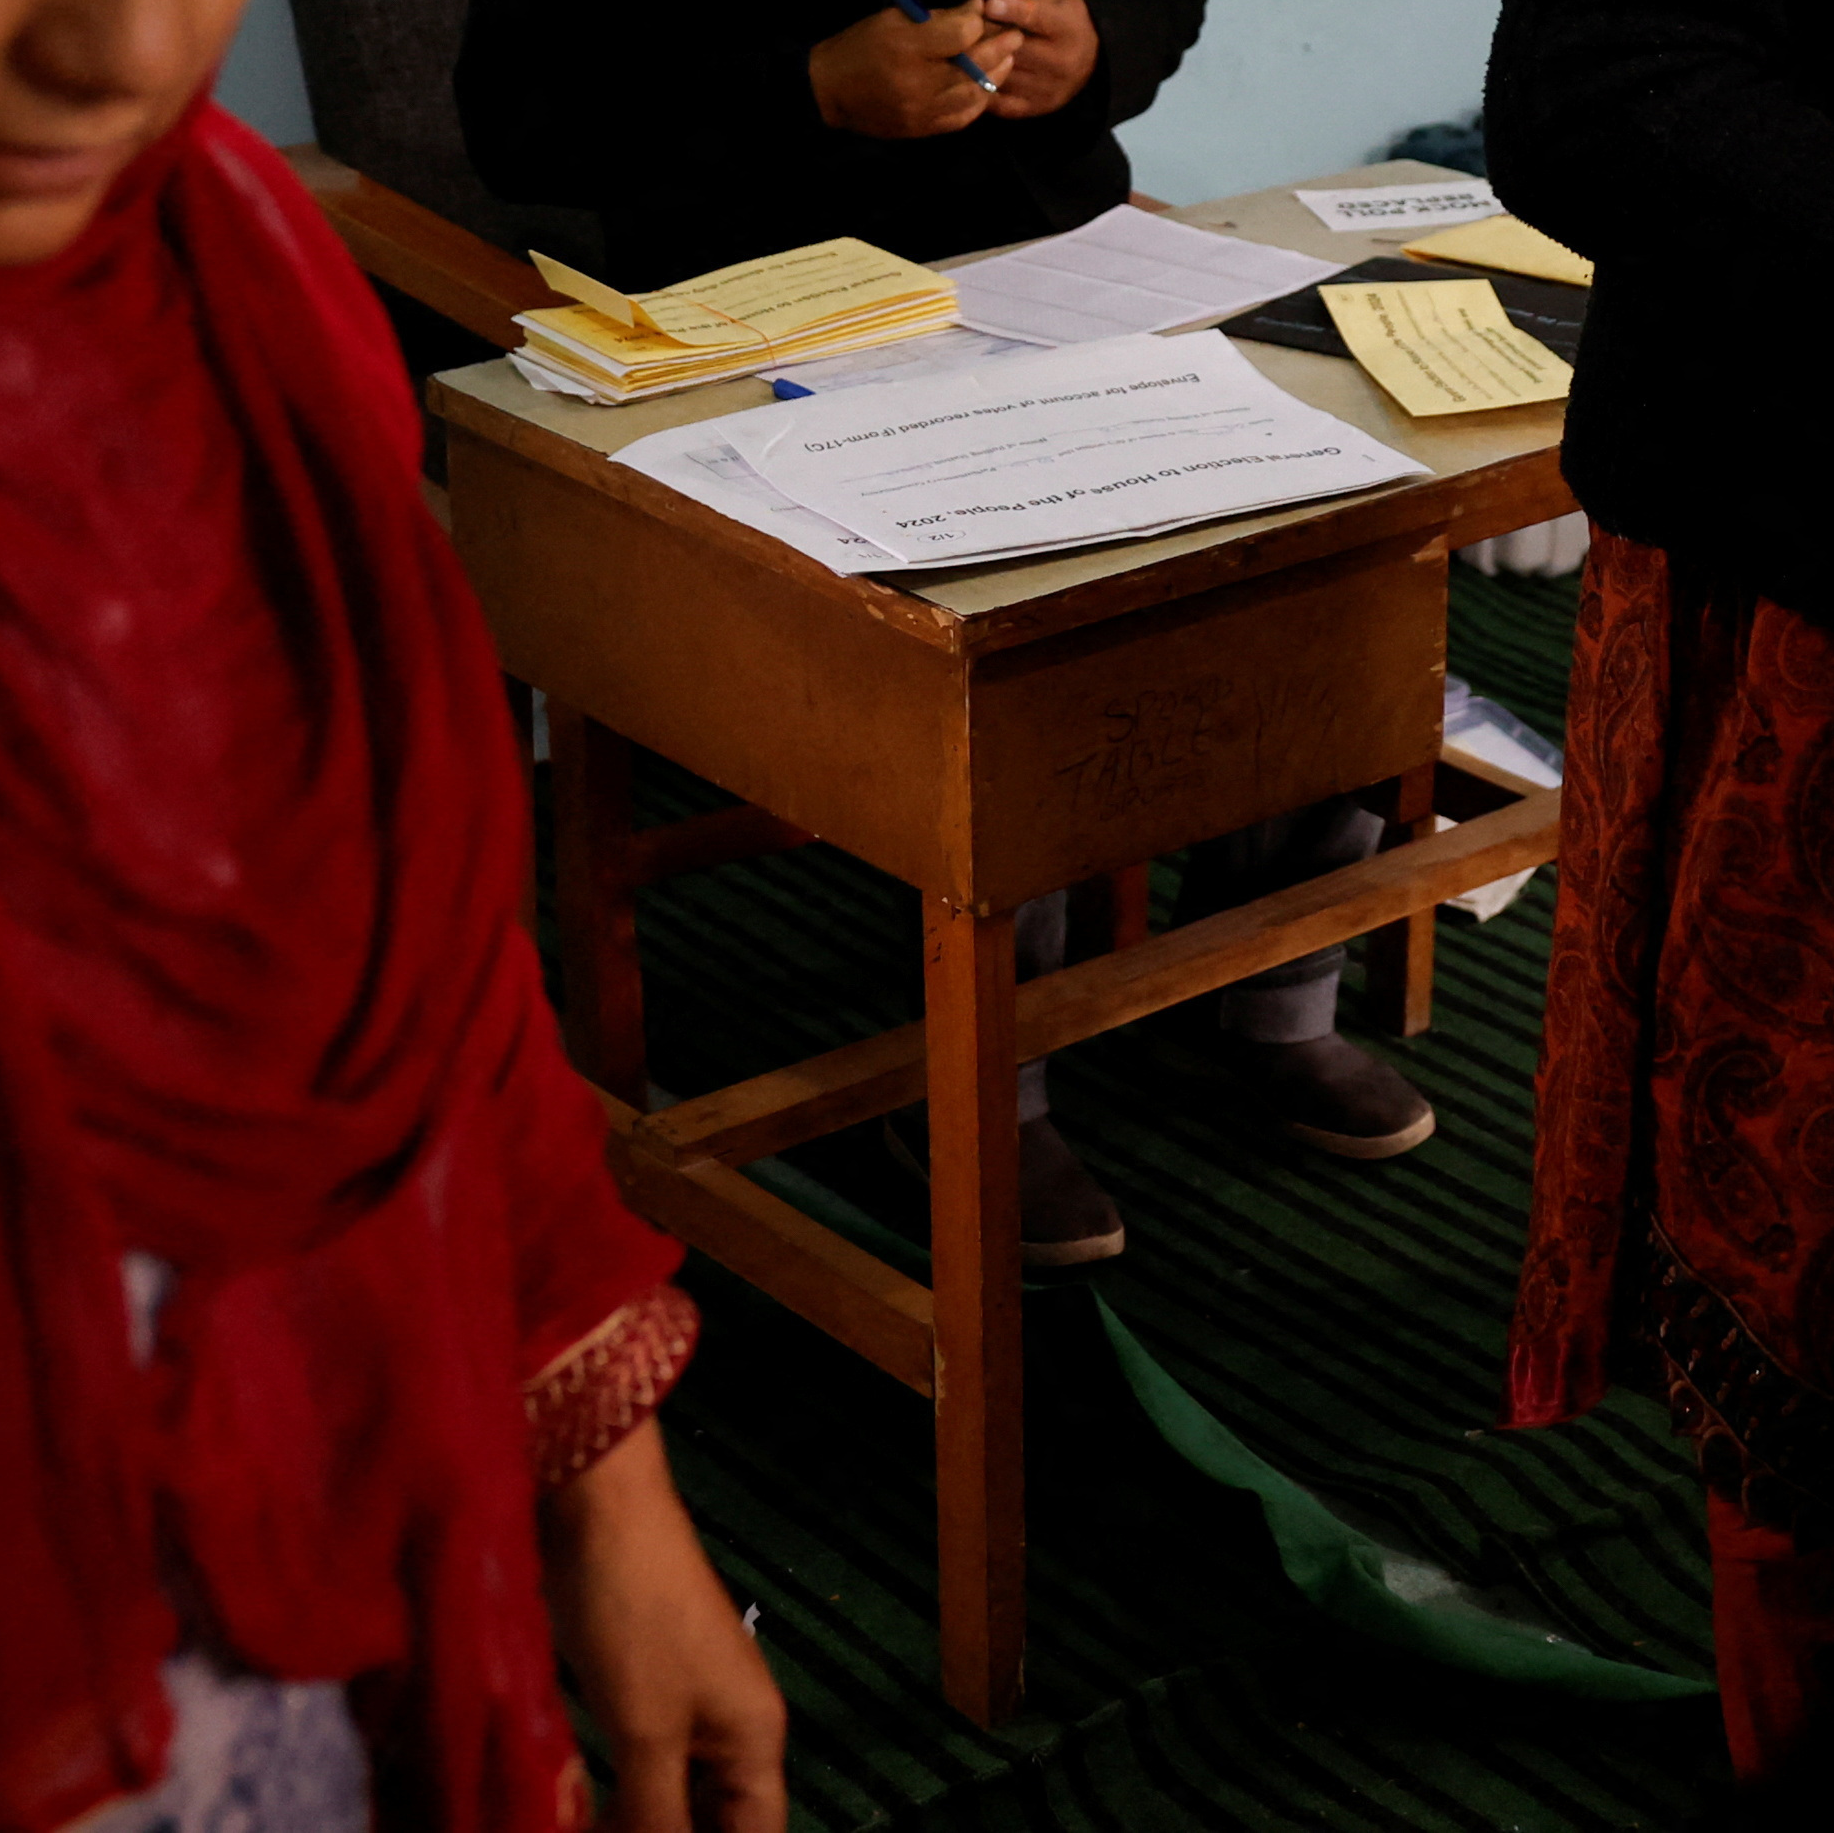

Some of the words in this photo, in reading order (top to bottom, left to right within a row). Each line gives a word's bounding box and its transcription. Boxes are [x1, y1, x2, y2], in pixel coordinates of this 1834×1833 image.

[1105, 384, 1128, 396] for
[1130, 372, 1201, 392] Envelope
[1019, 399, 1036, 408] of
[1041, 389, 1102, 406] account
[972, 402, 1018, 415] votes
[898, 411, 970, 435] recorded
[804, 425, 897, 453] (Form-17C)
[1265, 444, 1342, 463] General
[1158, 465, 1181, 478] to
[1184, 453, 1264, 474] Election
[1089, 472, 1157, 496] House
[1028, 493, 1063, 508] the
[1065, 487, 1086, 500] of
[946, 500, 1026, 517] People,
[894, 513, 948, 530] 2024
[1054, 696, 1212, 814] TABLE
